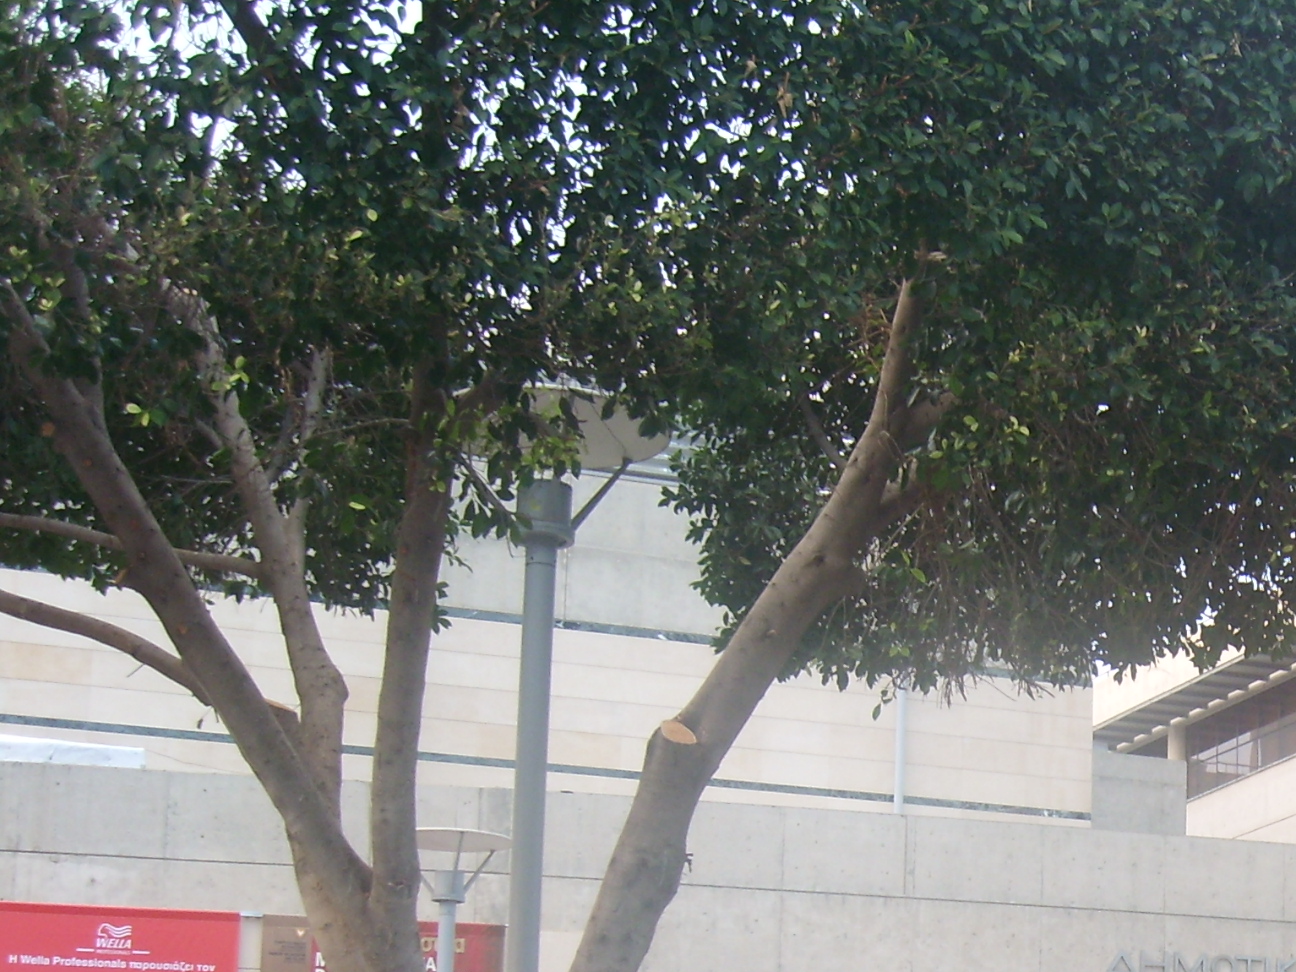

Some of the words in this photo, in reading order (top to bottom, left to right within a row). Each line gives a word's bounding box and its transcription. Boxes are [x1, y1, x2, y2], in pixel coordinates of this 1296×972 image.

[96, 938, 131, 949] WELLA
[20, 955, 50, 965] Wella
[53, 956, 127, 969] Professionals
[129, 960, 194, 972] παρουσιάζει
[197, 963, 216, 972] τον
